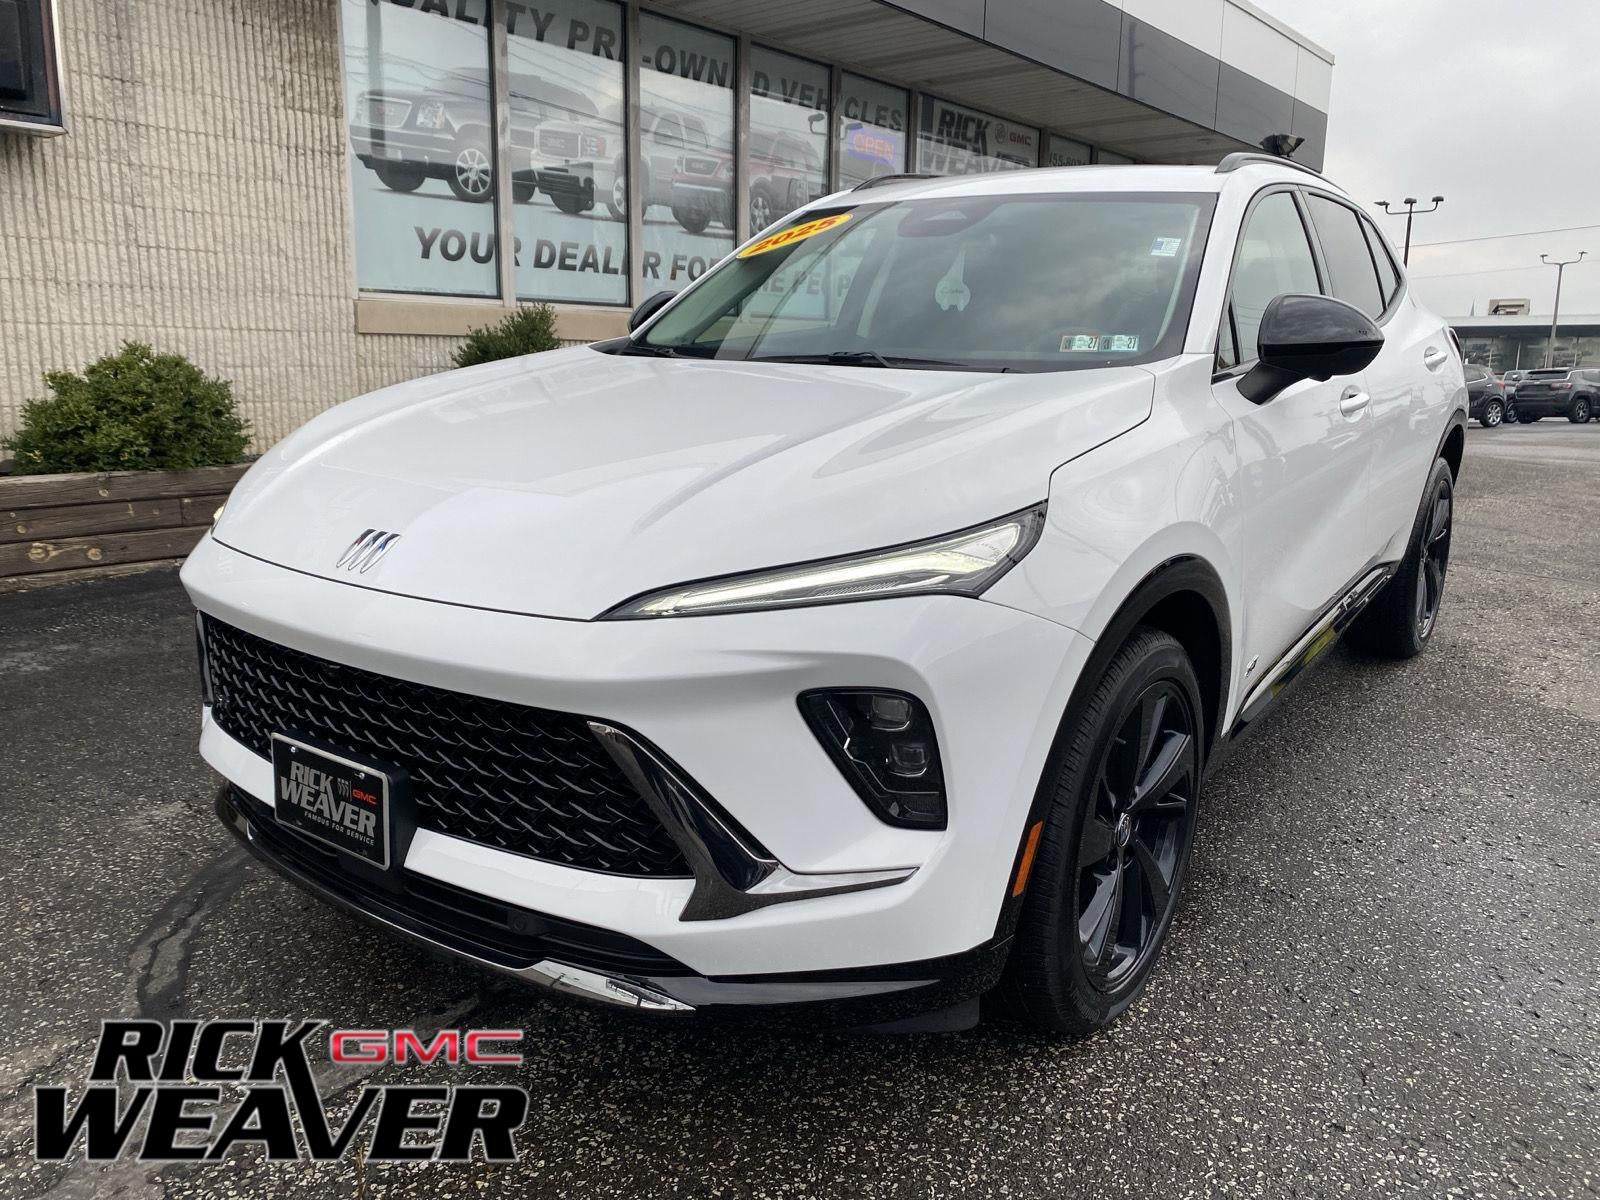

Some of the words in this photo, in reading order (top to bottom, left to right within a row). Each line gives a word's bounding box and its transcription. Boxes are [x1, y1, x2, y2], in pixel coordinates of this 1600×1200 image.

[567, 18, 770, 98] PR-OWND
[781, 78, 902, 131] VEHCLES
[852, 132, 896, 159] OPEN
[937, 110, 991, 155] RICK
[1008, 131, 1032, 146] GMC
[748, 217, 839, 254] 2025
[290, 760, 334, 794] RICK
[280, 775, 377, 838] WEAVER
[352, 788, 378, 805] GMC
[304, 810, 330, 827] FAMOUS
[331, 822, 344, 834] FOR
[346, 829, 375, 846] SERVICE
